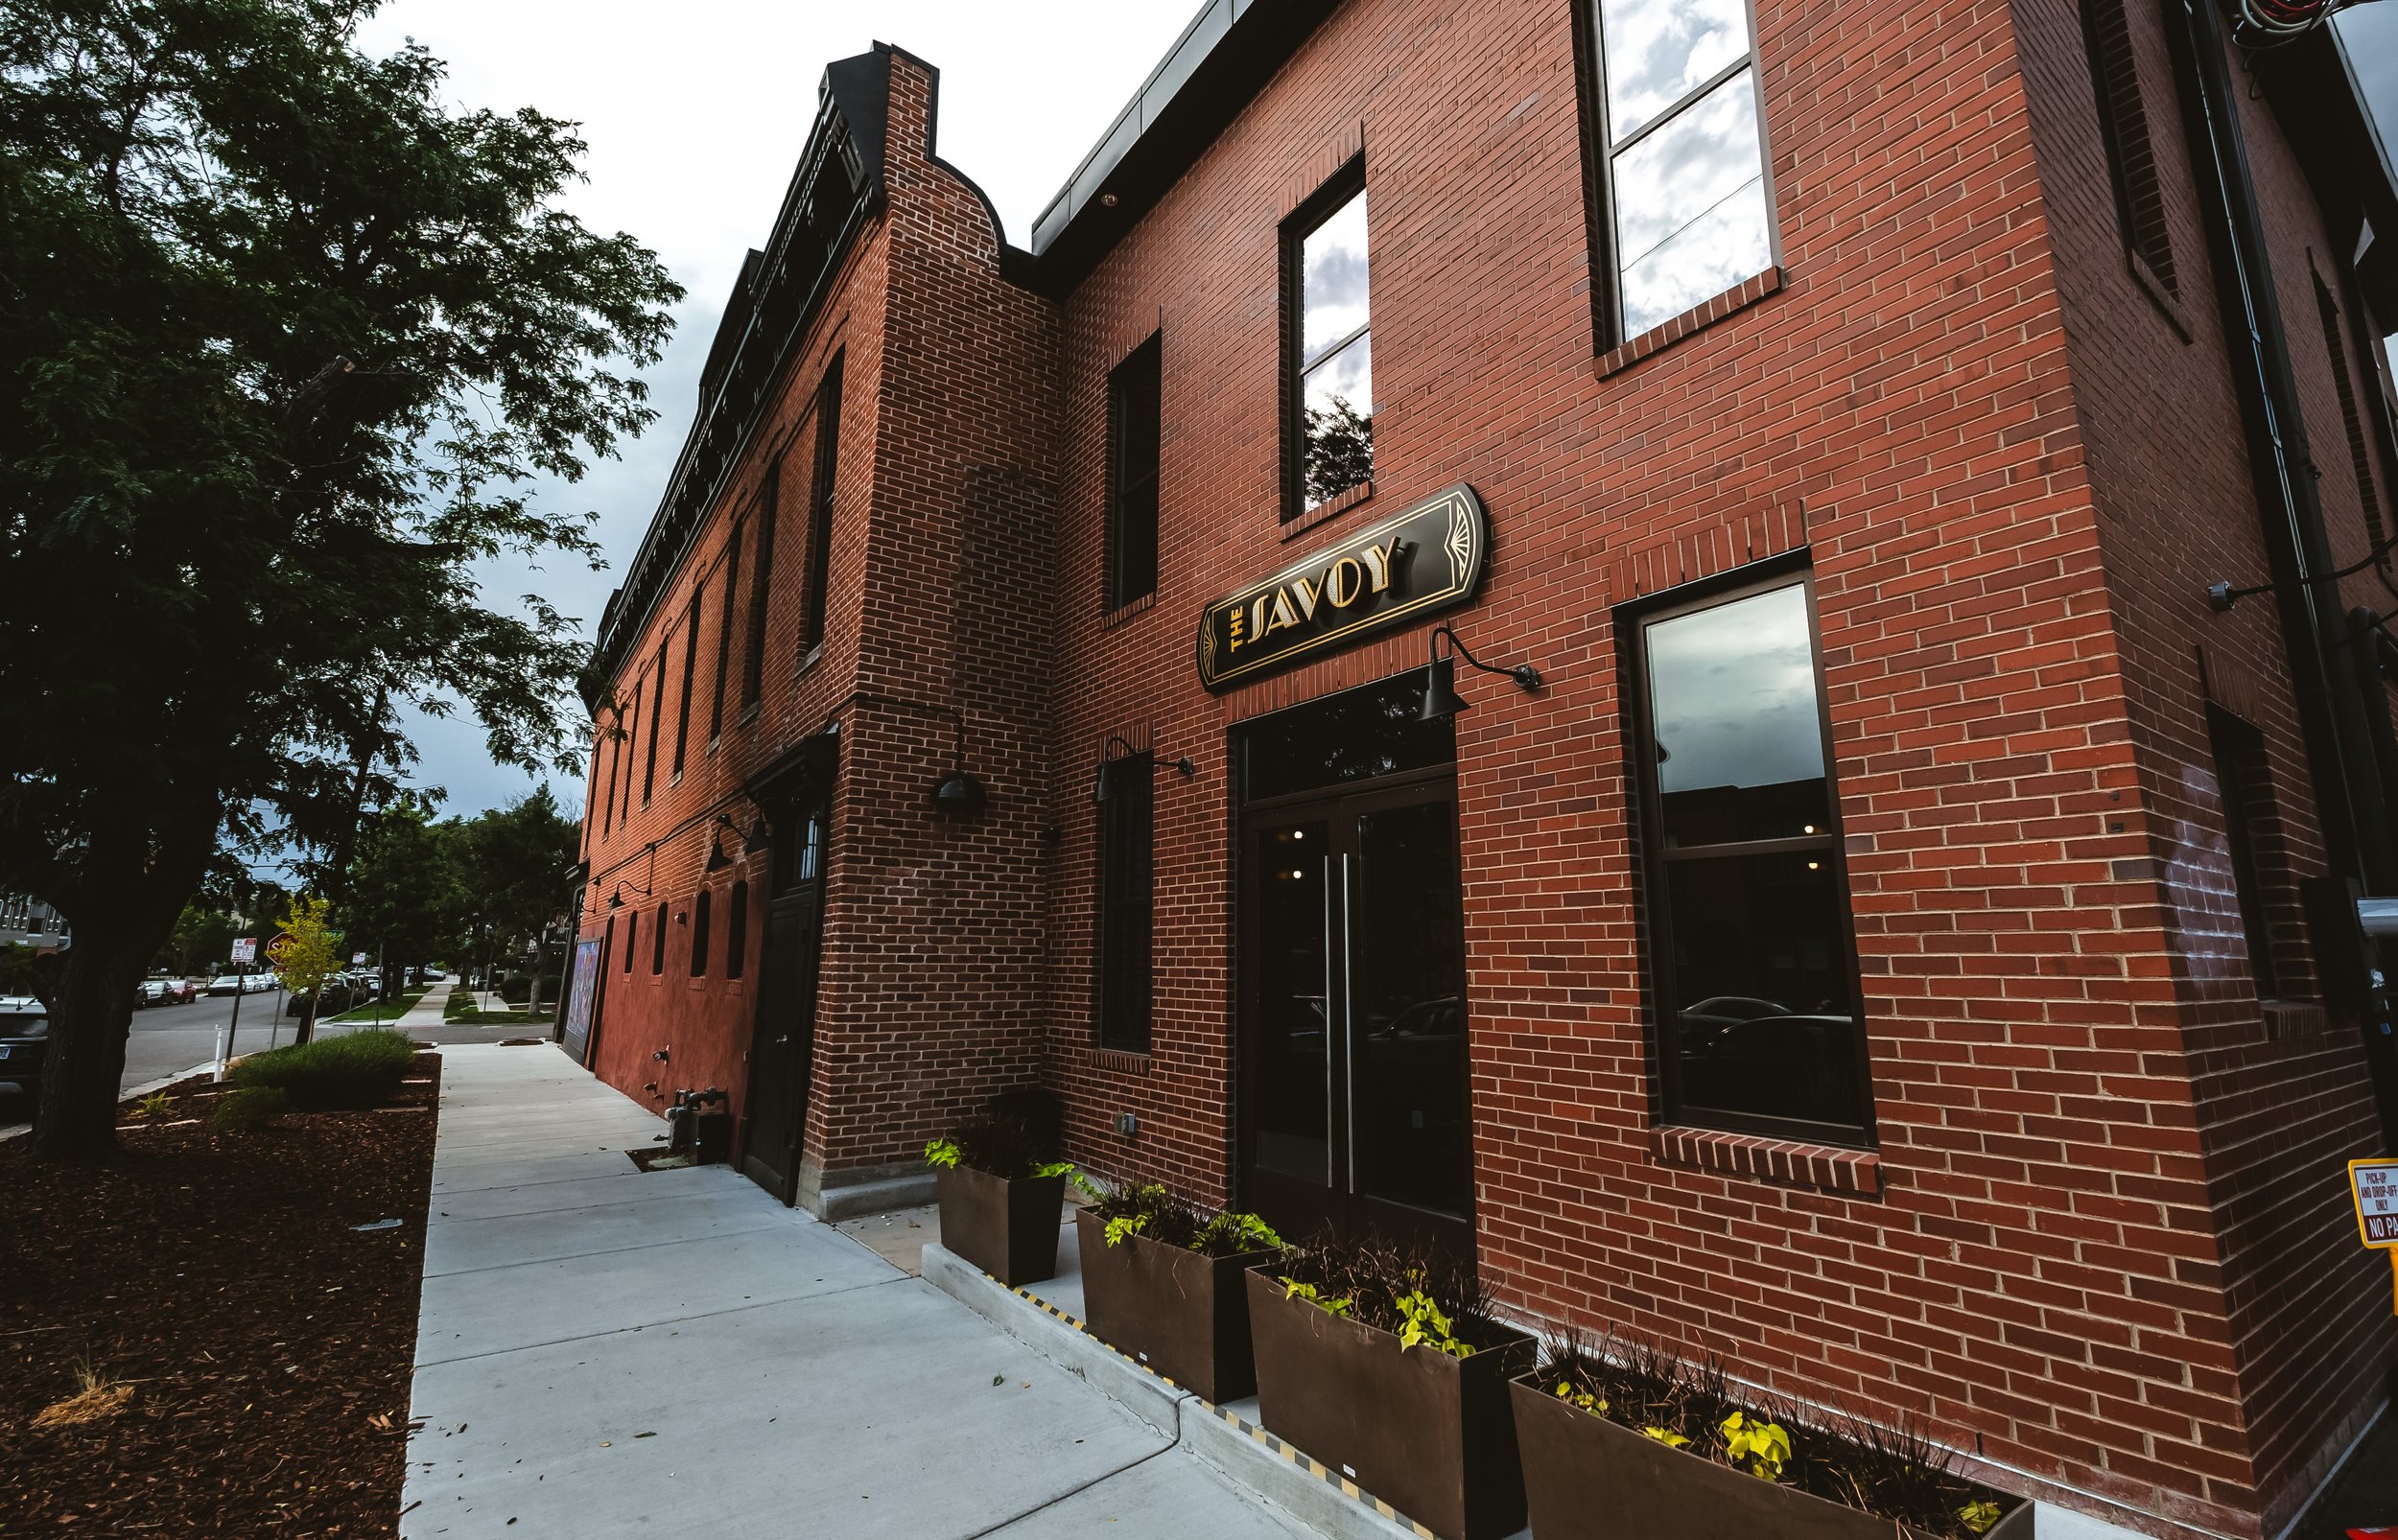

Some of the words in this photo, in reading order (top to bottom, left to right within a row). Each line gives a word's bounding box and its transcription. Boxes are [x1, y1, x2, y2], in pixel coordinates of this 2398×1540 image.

[1231, 605, 1243, 652] THE
[1247, 535, 1399, 644] SAVOY
[2365, 1173, 2386, 1184] PICK-UP
[2362, 1187, 2371, 1198] AND
[2372, 1185, 2397, 1198] DROP-OFF
[2376, 1200, 2387, 1211] ONLY
[2369, 1218, 2385, 1238] NO
